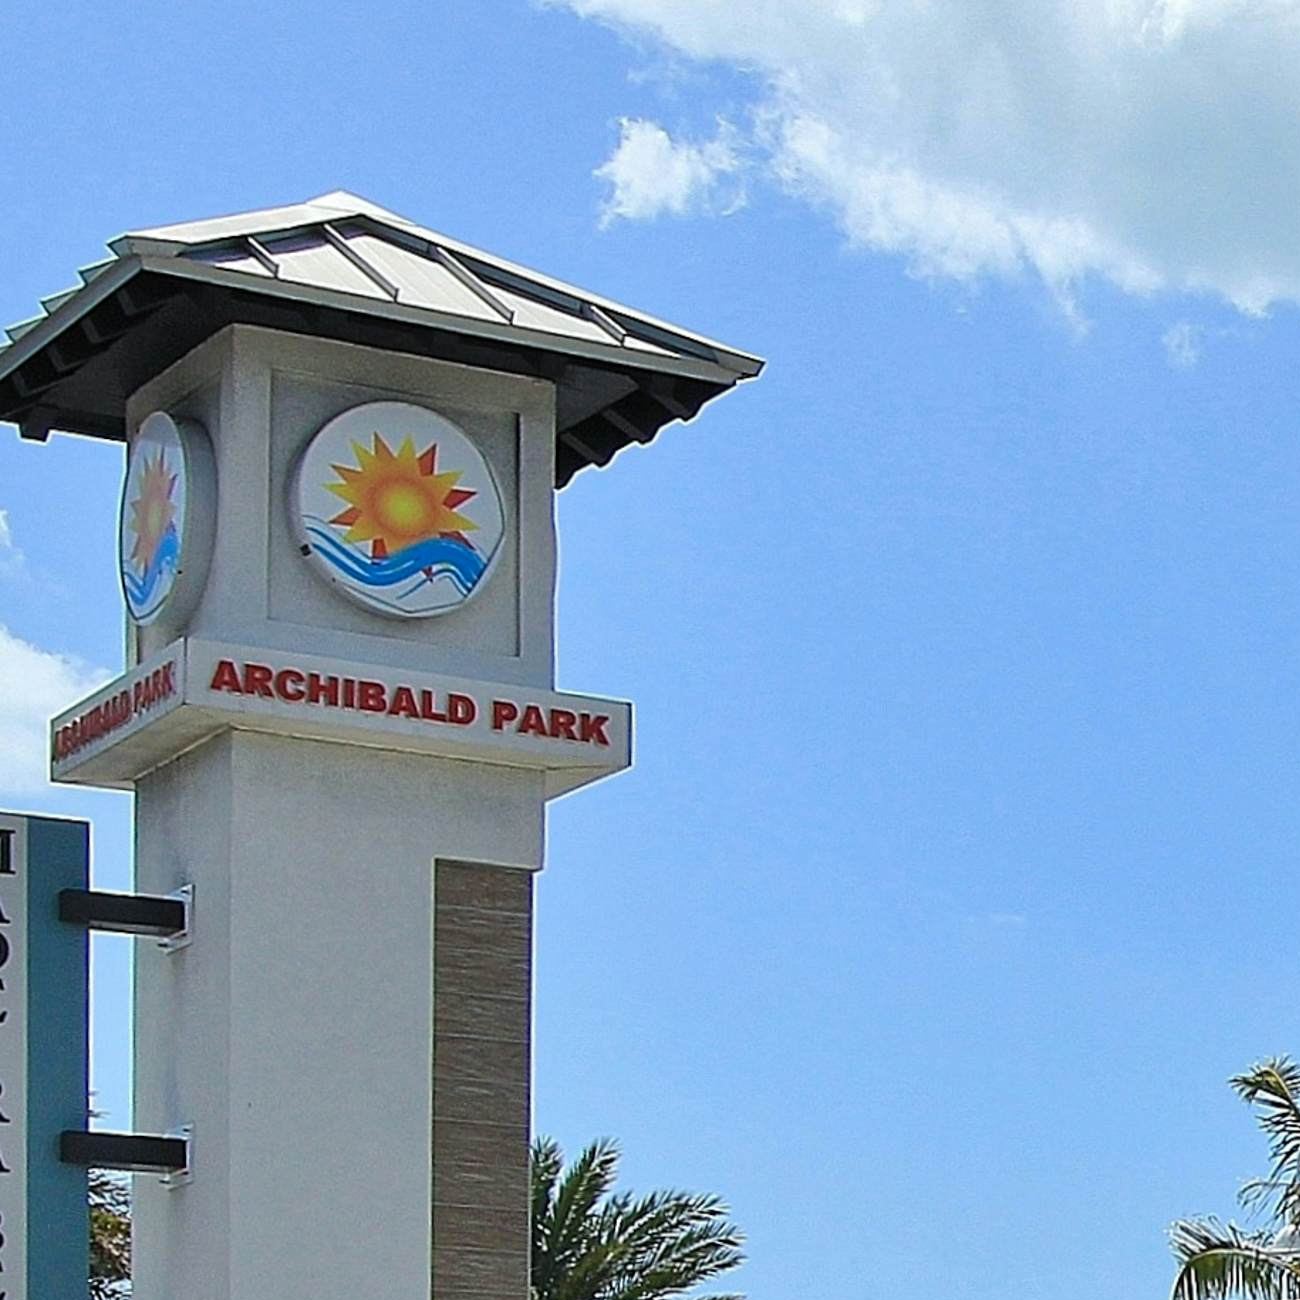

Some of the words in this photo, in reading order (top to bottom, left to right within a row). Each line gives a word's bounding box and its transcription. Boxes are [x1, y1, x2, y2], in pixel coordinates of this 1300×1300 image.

[133, 661, 176, 714] PARK
[210, 660, 476, 726] ARCHIBALD
[492, 699, 610, 746] PARK
